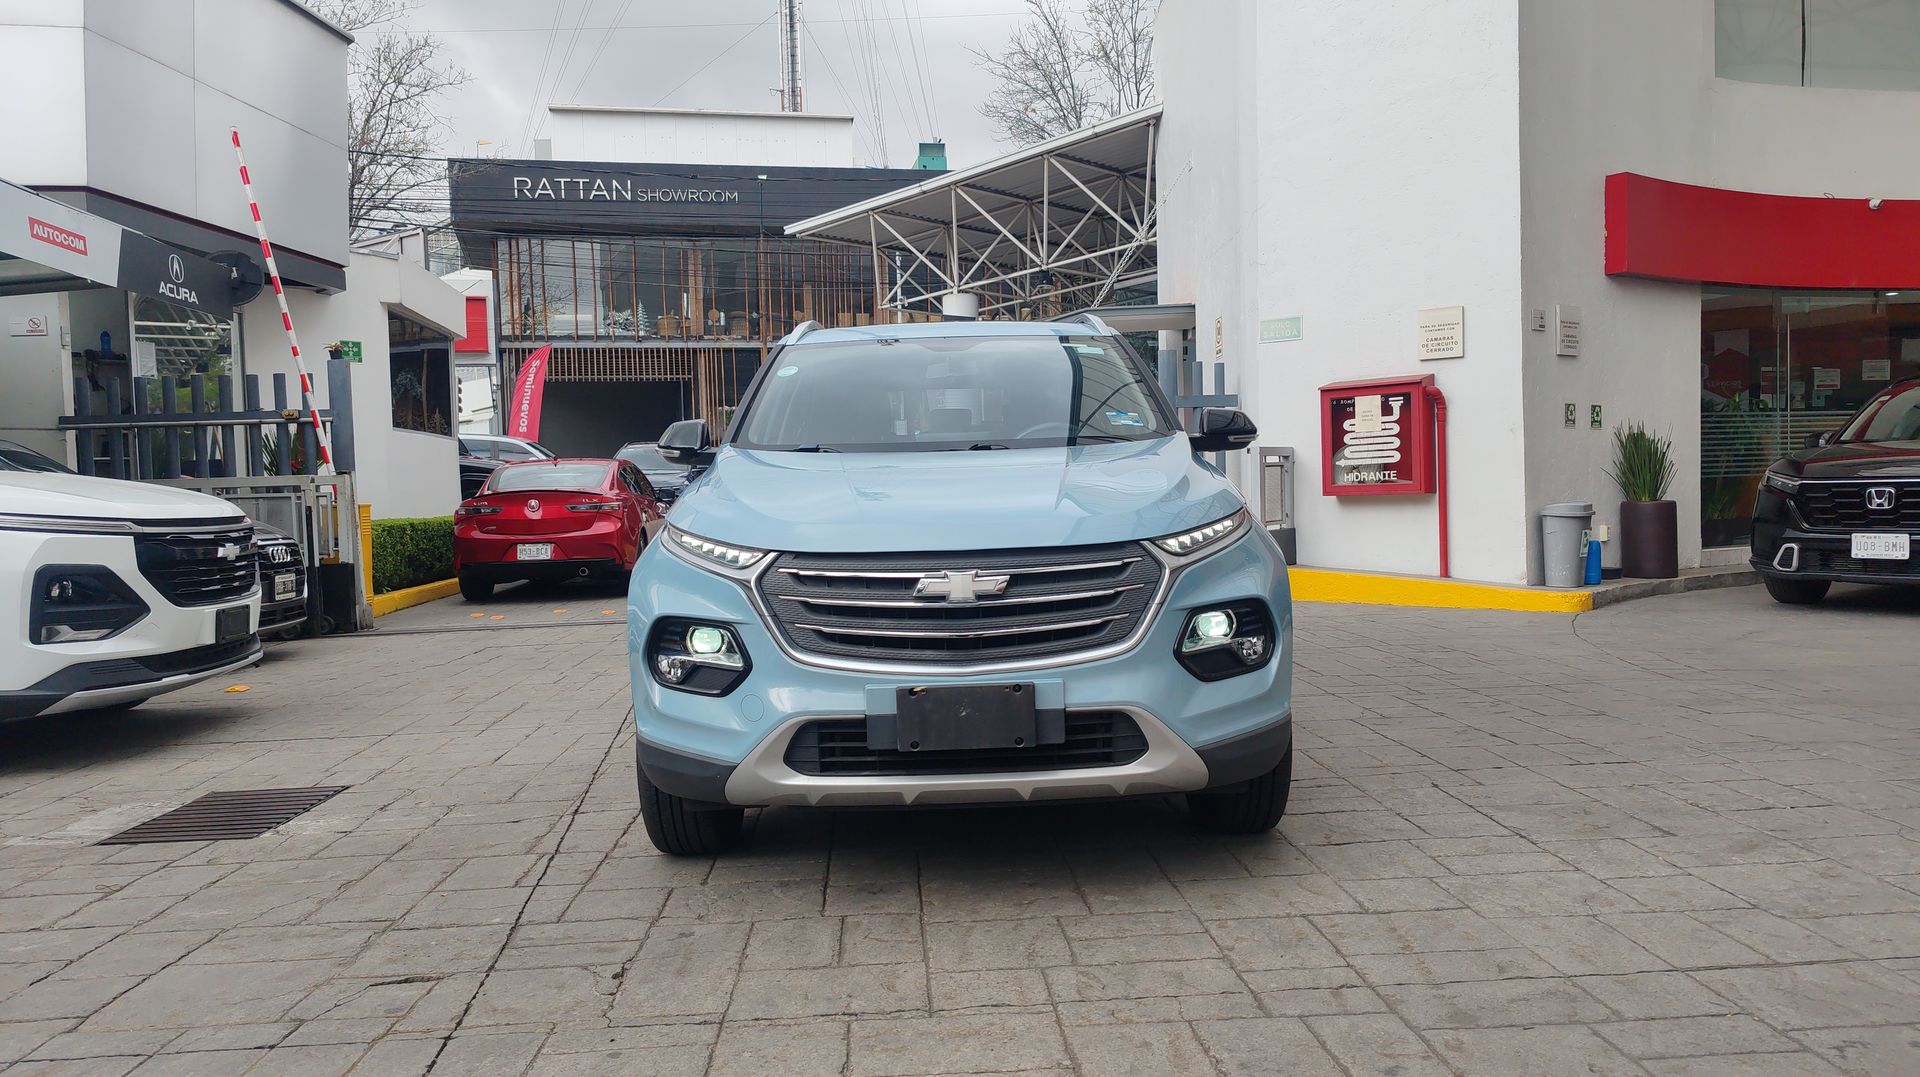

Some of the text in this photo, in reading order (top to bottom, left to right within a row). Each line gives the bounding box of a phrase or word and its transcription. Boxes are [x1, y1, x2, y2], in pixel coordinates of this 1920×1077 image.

[513, 177, 739, 203] RATTAN SHOWROOM
[33, 223, 85, 251] AUTOCOM
[158, 281, 199, 305] ACURA
[1263, 329, 1298, 338] SALIDA
[519, 359, 541, 433] Seminuevos
[1344, 470, 1398, 482] HIDRANTE
